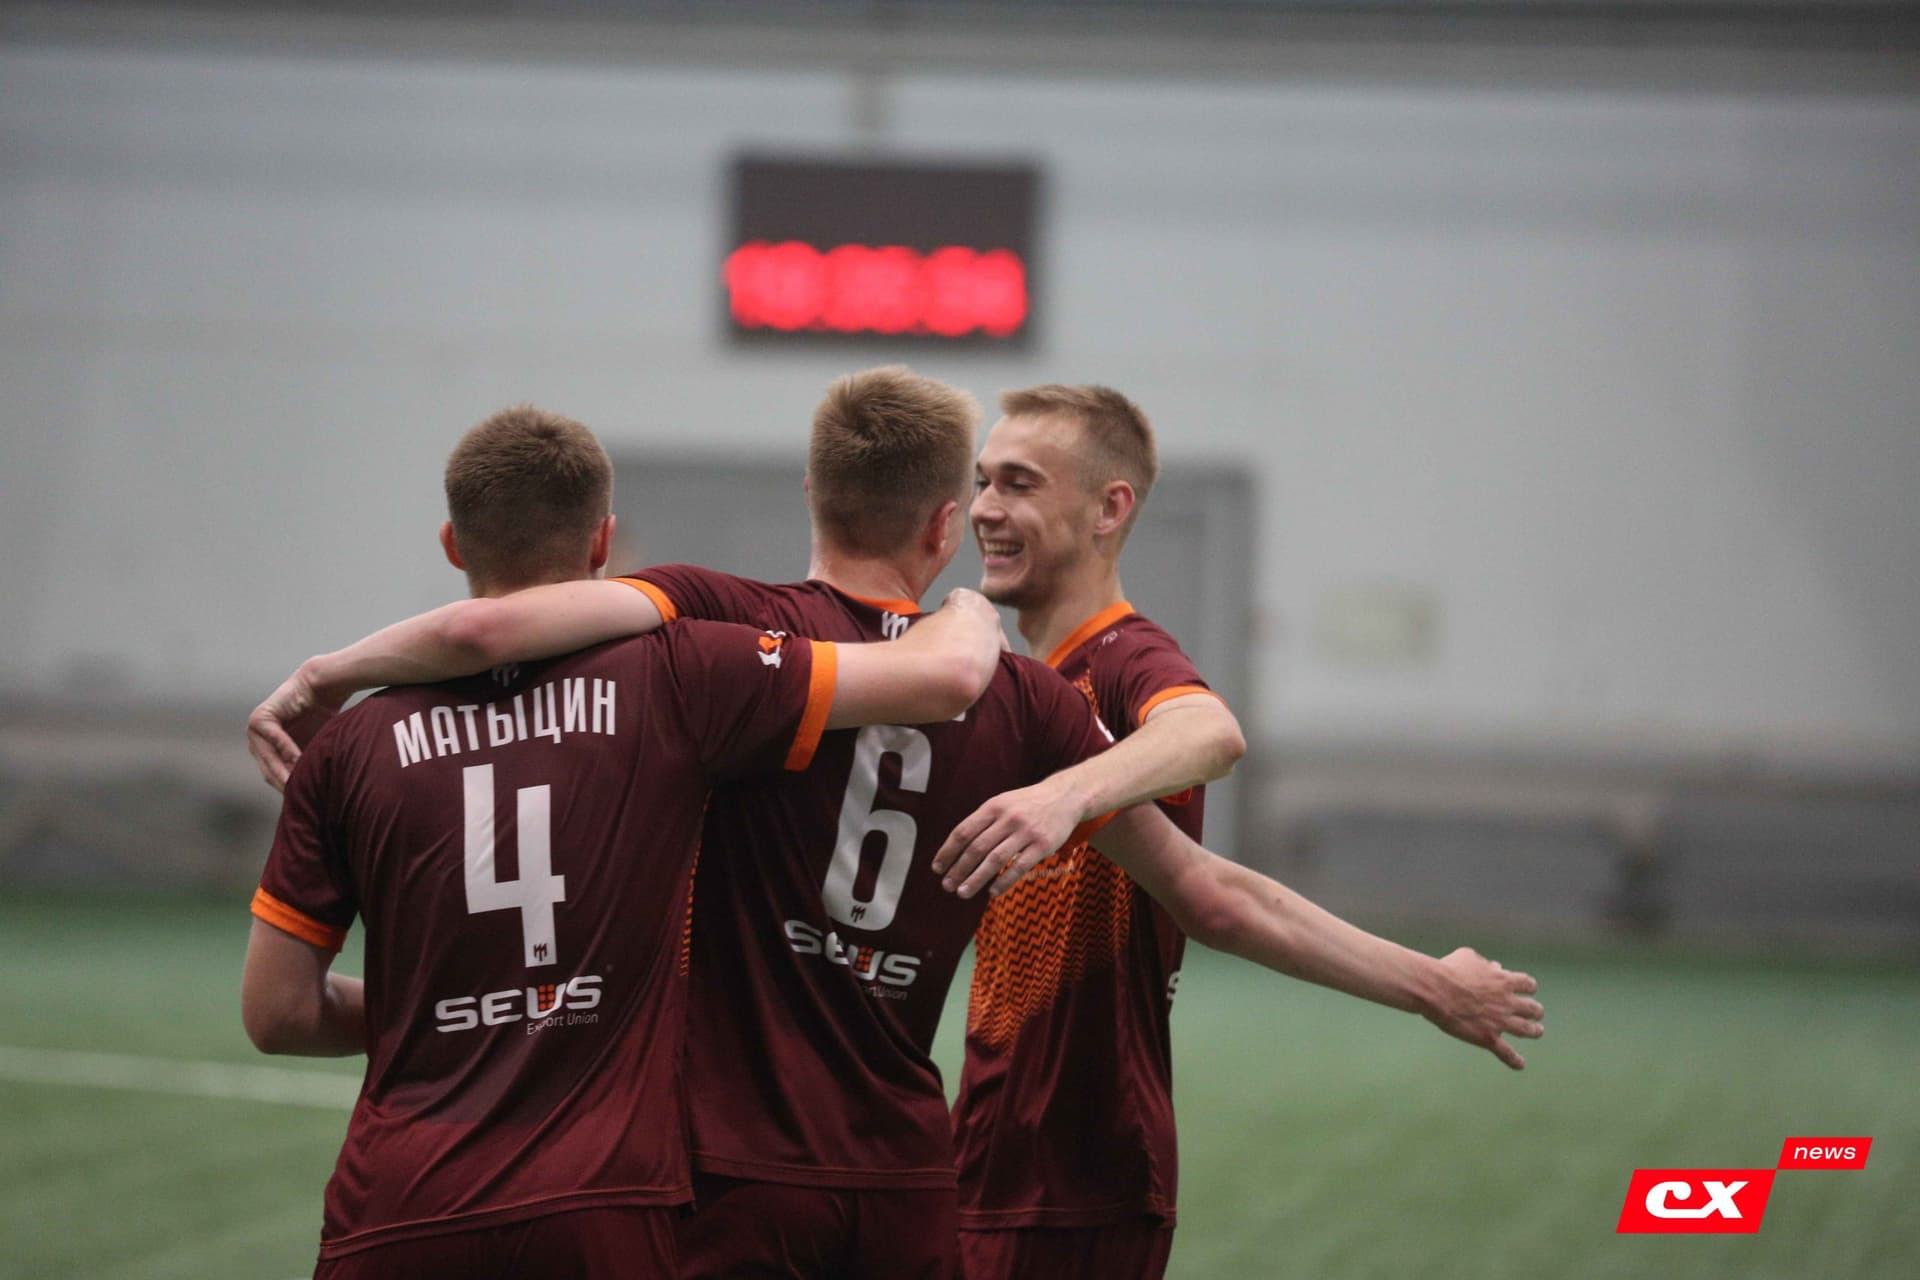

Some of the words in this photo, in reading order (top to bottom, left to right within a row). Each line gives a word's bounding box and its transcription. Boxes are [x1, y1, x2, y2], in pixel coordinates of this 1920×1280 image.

[393, 677, 616, 768] МАТЫЦИН
[463, 763, 566, 968] 4
[822, 724, 932, 931] 6
[435, 975, 603, 1033] SEUS
[567, 1012, 599, 1026] Union
